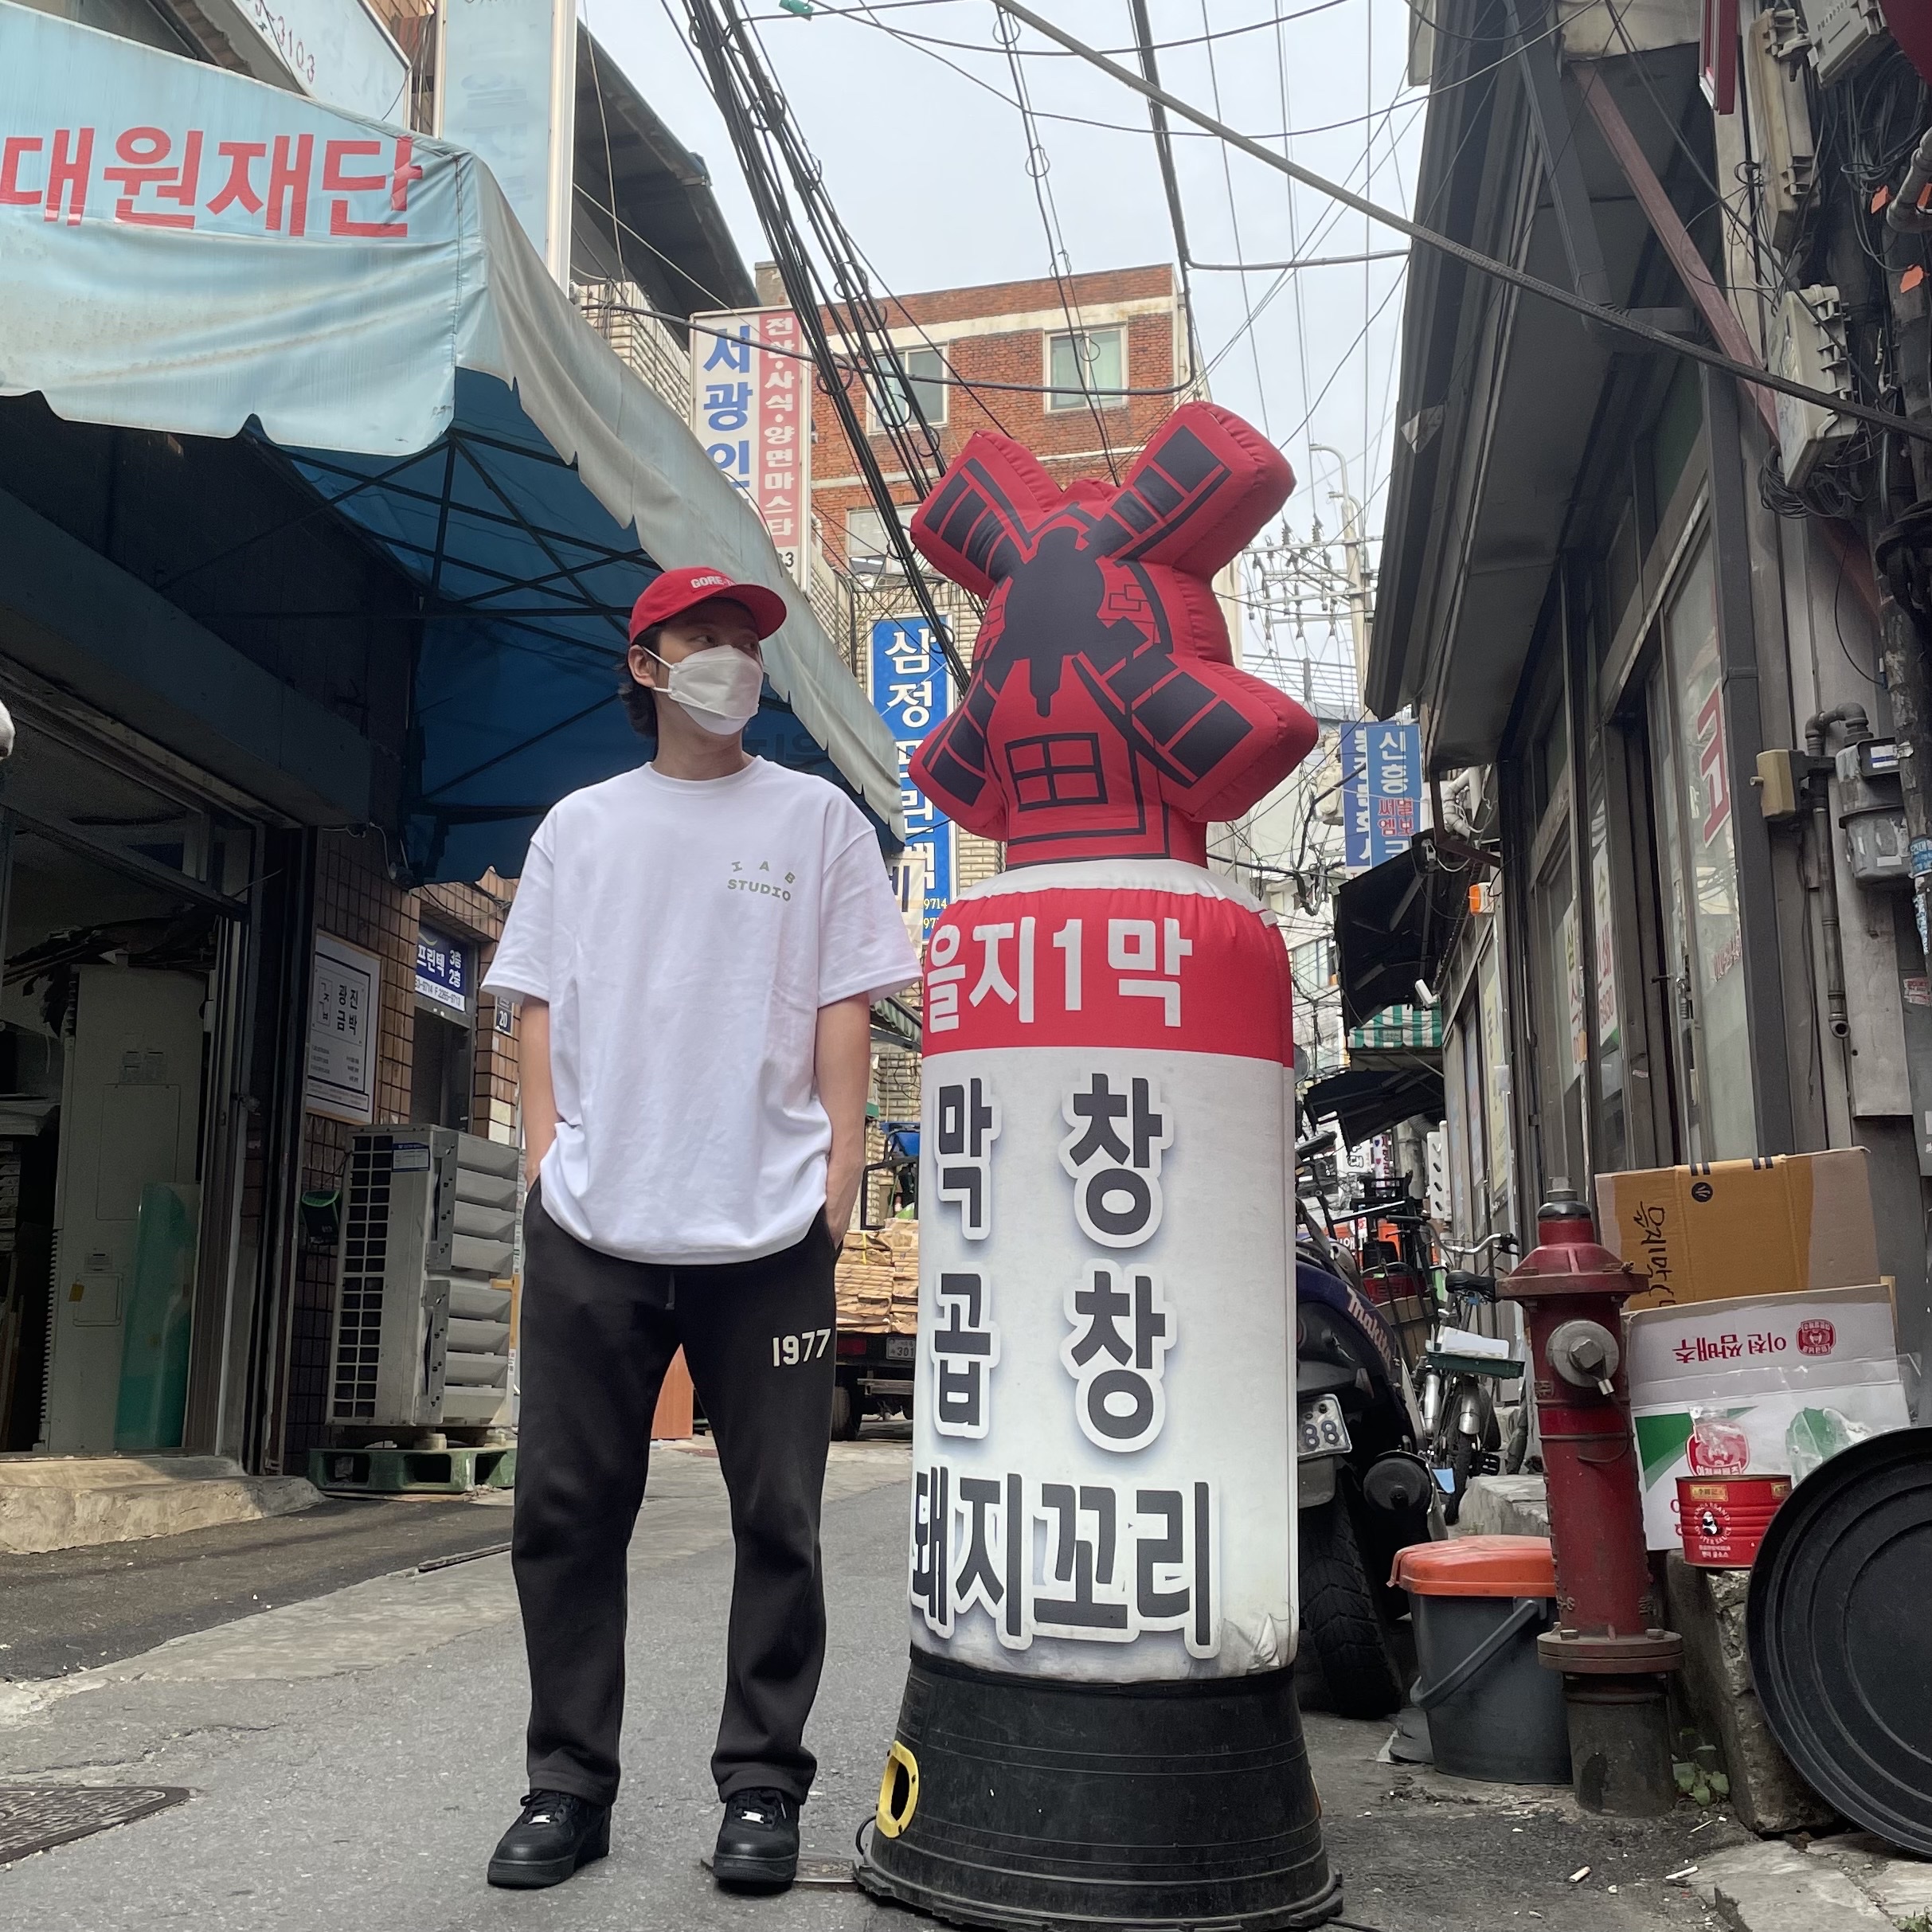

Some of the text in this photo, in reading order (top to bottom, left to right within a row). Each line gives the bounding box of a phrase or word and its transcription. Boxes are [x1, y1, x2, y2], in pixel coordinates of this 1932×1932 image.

[0, 125, 423, 237] 대원재단
[702, 325, 753, 505] 서광인
[1379, 731, 1409, 795] 신흥
[727, 878, 792, 901] STUDIO
[448, 968, 462, 988] 2층
[449, 949, 462, 969] 3층
[927, 916, 1193, 1034] 을지1막
[772, 1328, 832, 1367] 1977
[1672, 1333, 1743, 1364] 쌈배추
[1747, 1332, 1787, 1355] 이천
[912, 1466, 1210, 1646] 돼지꼬리
